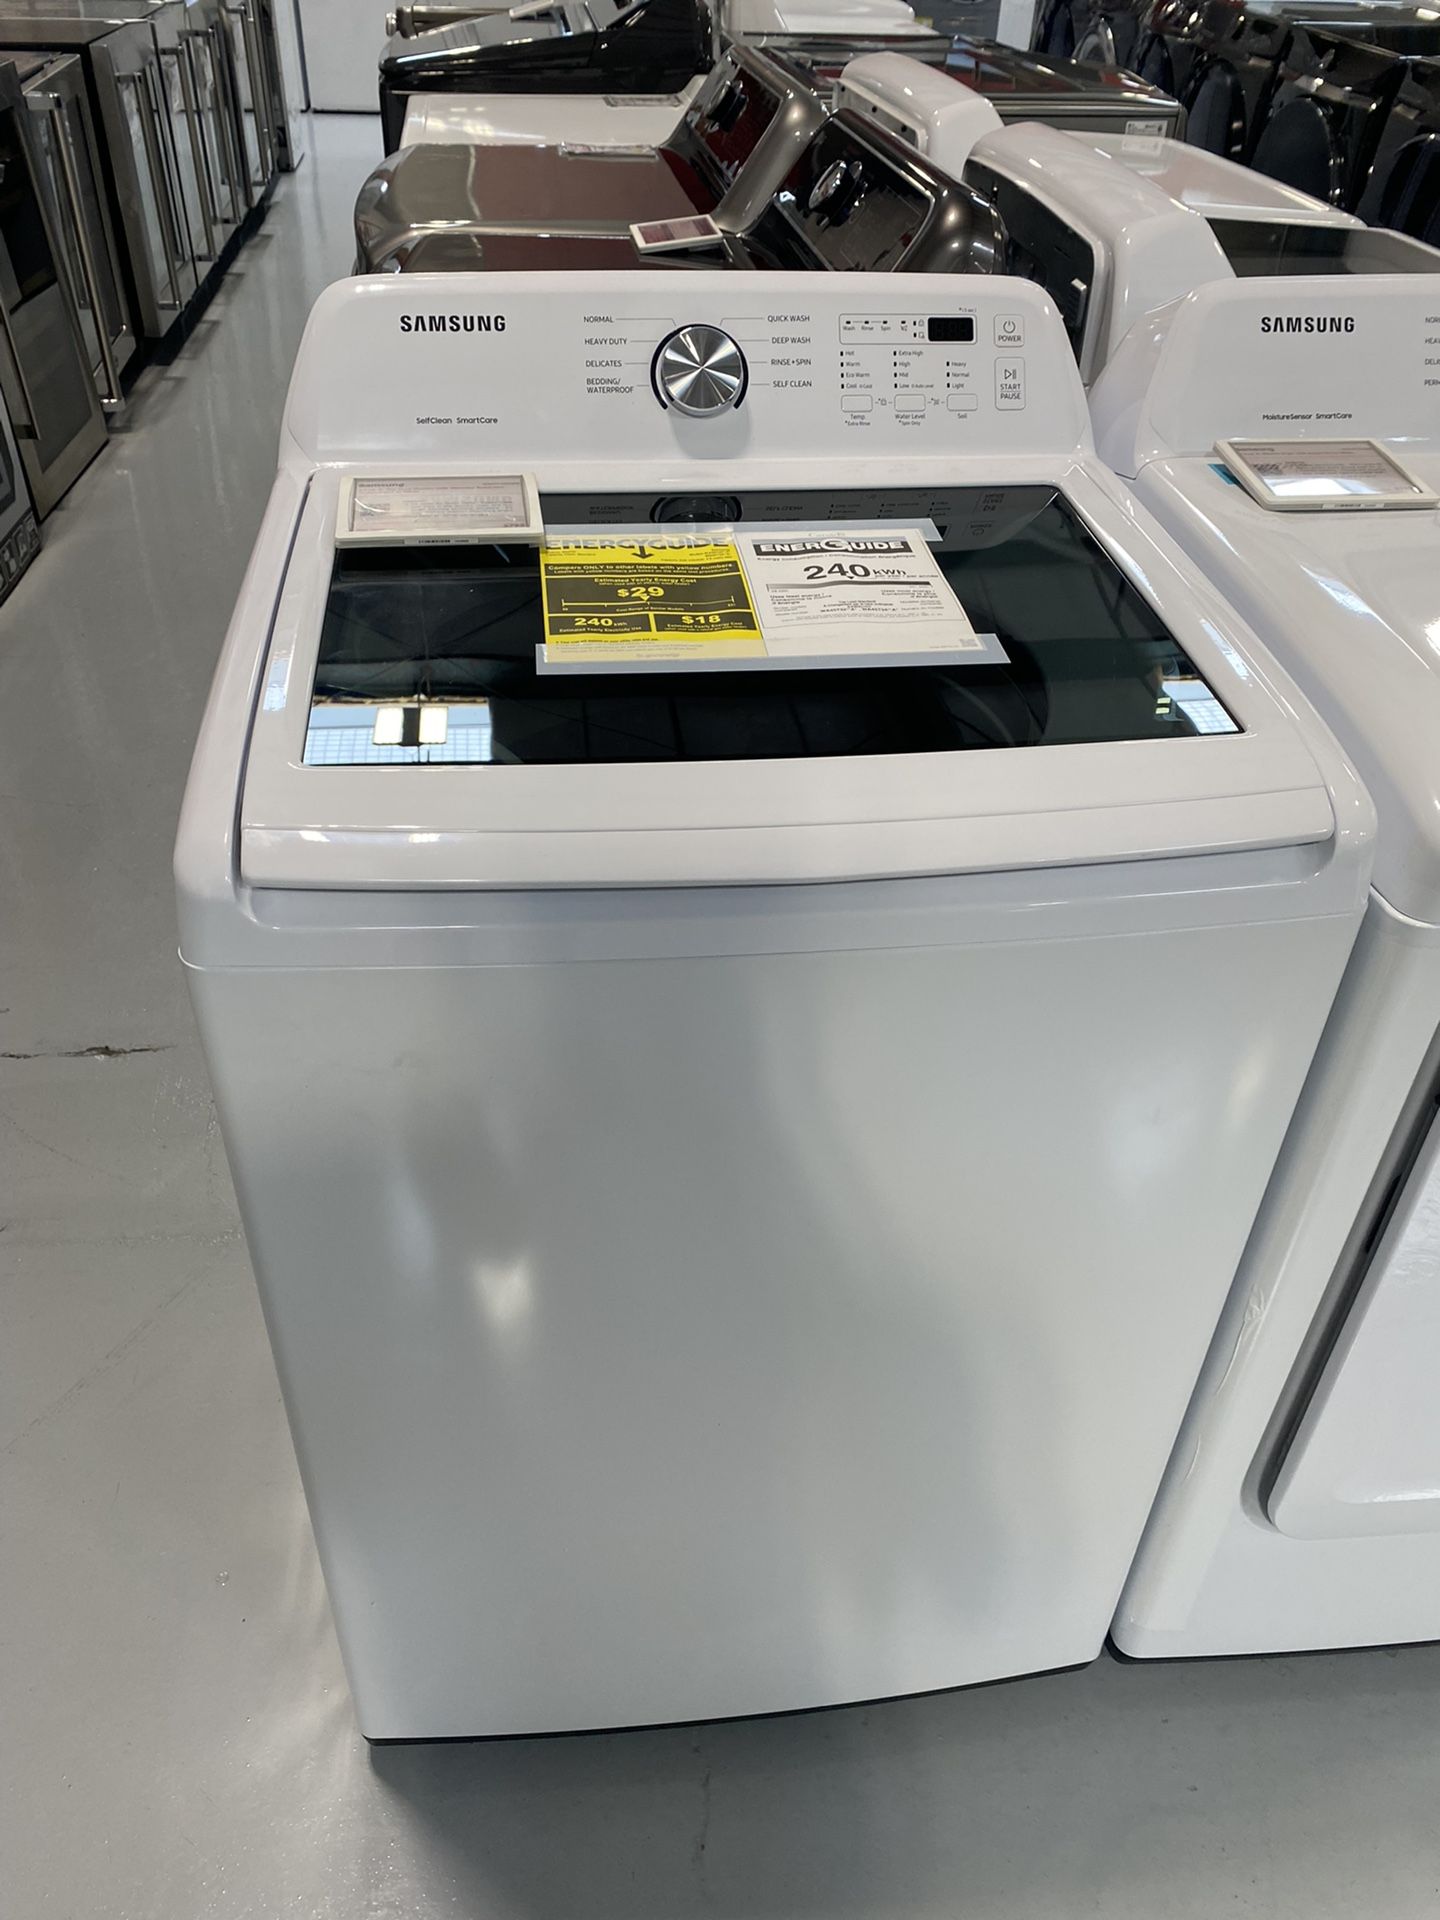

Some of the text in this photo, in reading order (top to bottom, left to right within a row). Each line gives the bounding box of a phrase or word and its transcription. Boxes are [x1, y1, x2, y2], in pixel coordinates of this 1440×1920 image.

[400, 315, 506, 332] SAMSUNG
[1260, 317, 1355, 333] SAMSUNG
[772, 380, 812, 388] SELF CLEAN
[587, 386, 634, 394] WATERPROOF
[1000, 392, 1021, 400] PAUSE
[760, 538, 905, 552] ENERGUIDE
[803, 563, 871, 580] 240
[616, 586, 665, 598] $29
[574, 617, 613, 627] 240
[681, 615, 721, 625] $18
